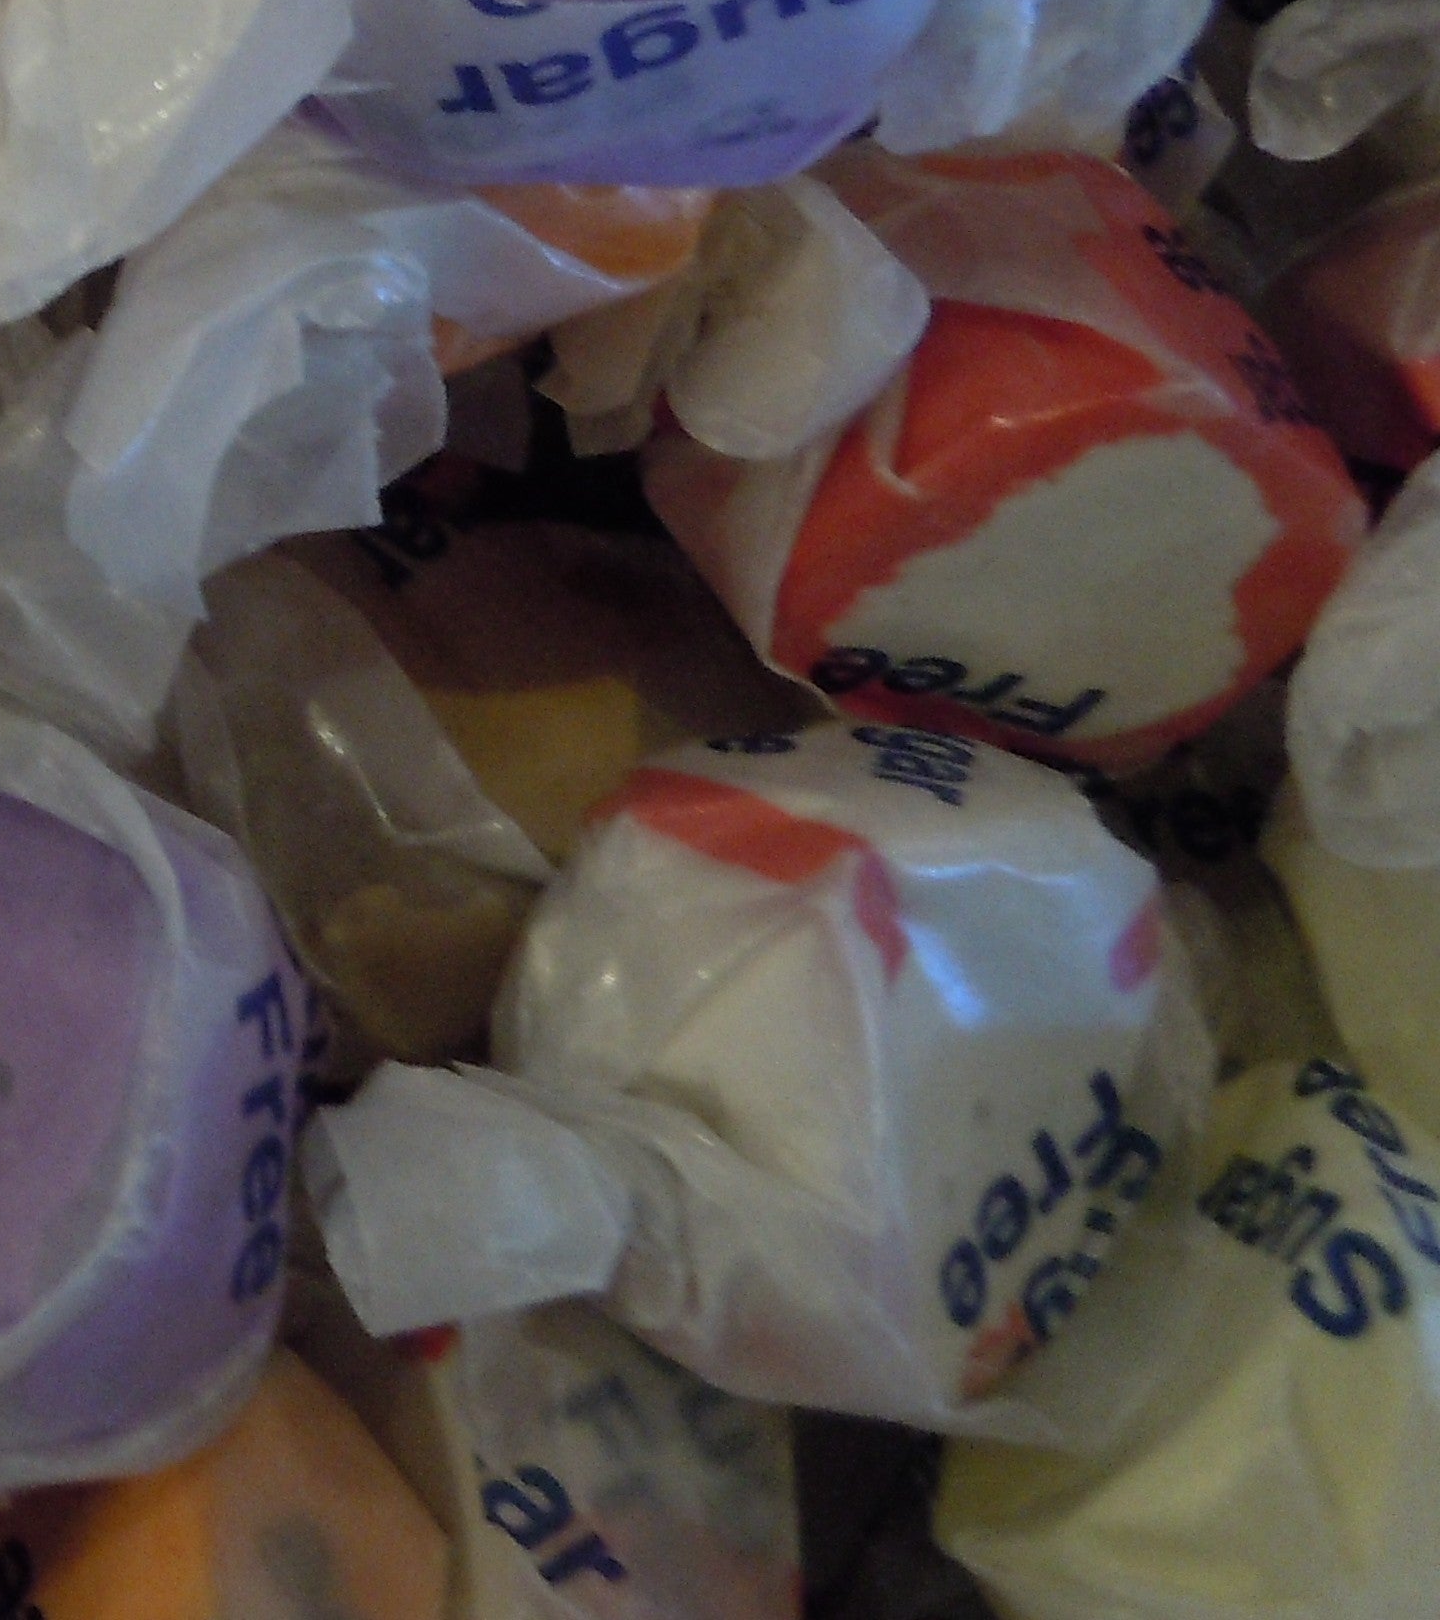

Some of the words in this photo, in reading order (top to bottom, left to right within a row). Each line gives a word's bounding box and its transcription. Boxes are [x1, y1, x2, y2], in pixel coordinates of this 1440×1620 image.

[813, 644, 1106, 740] Free
[231, 970, 295, 1303] Free
[941, 1072, 1135, 1329] Free
